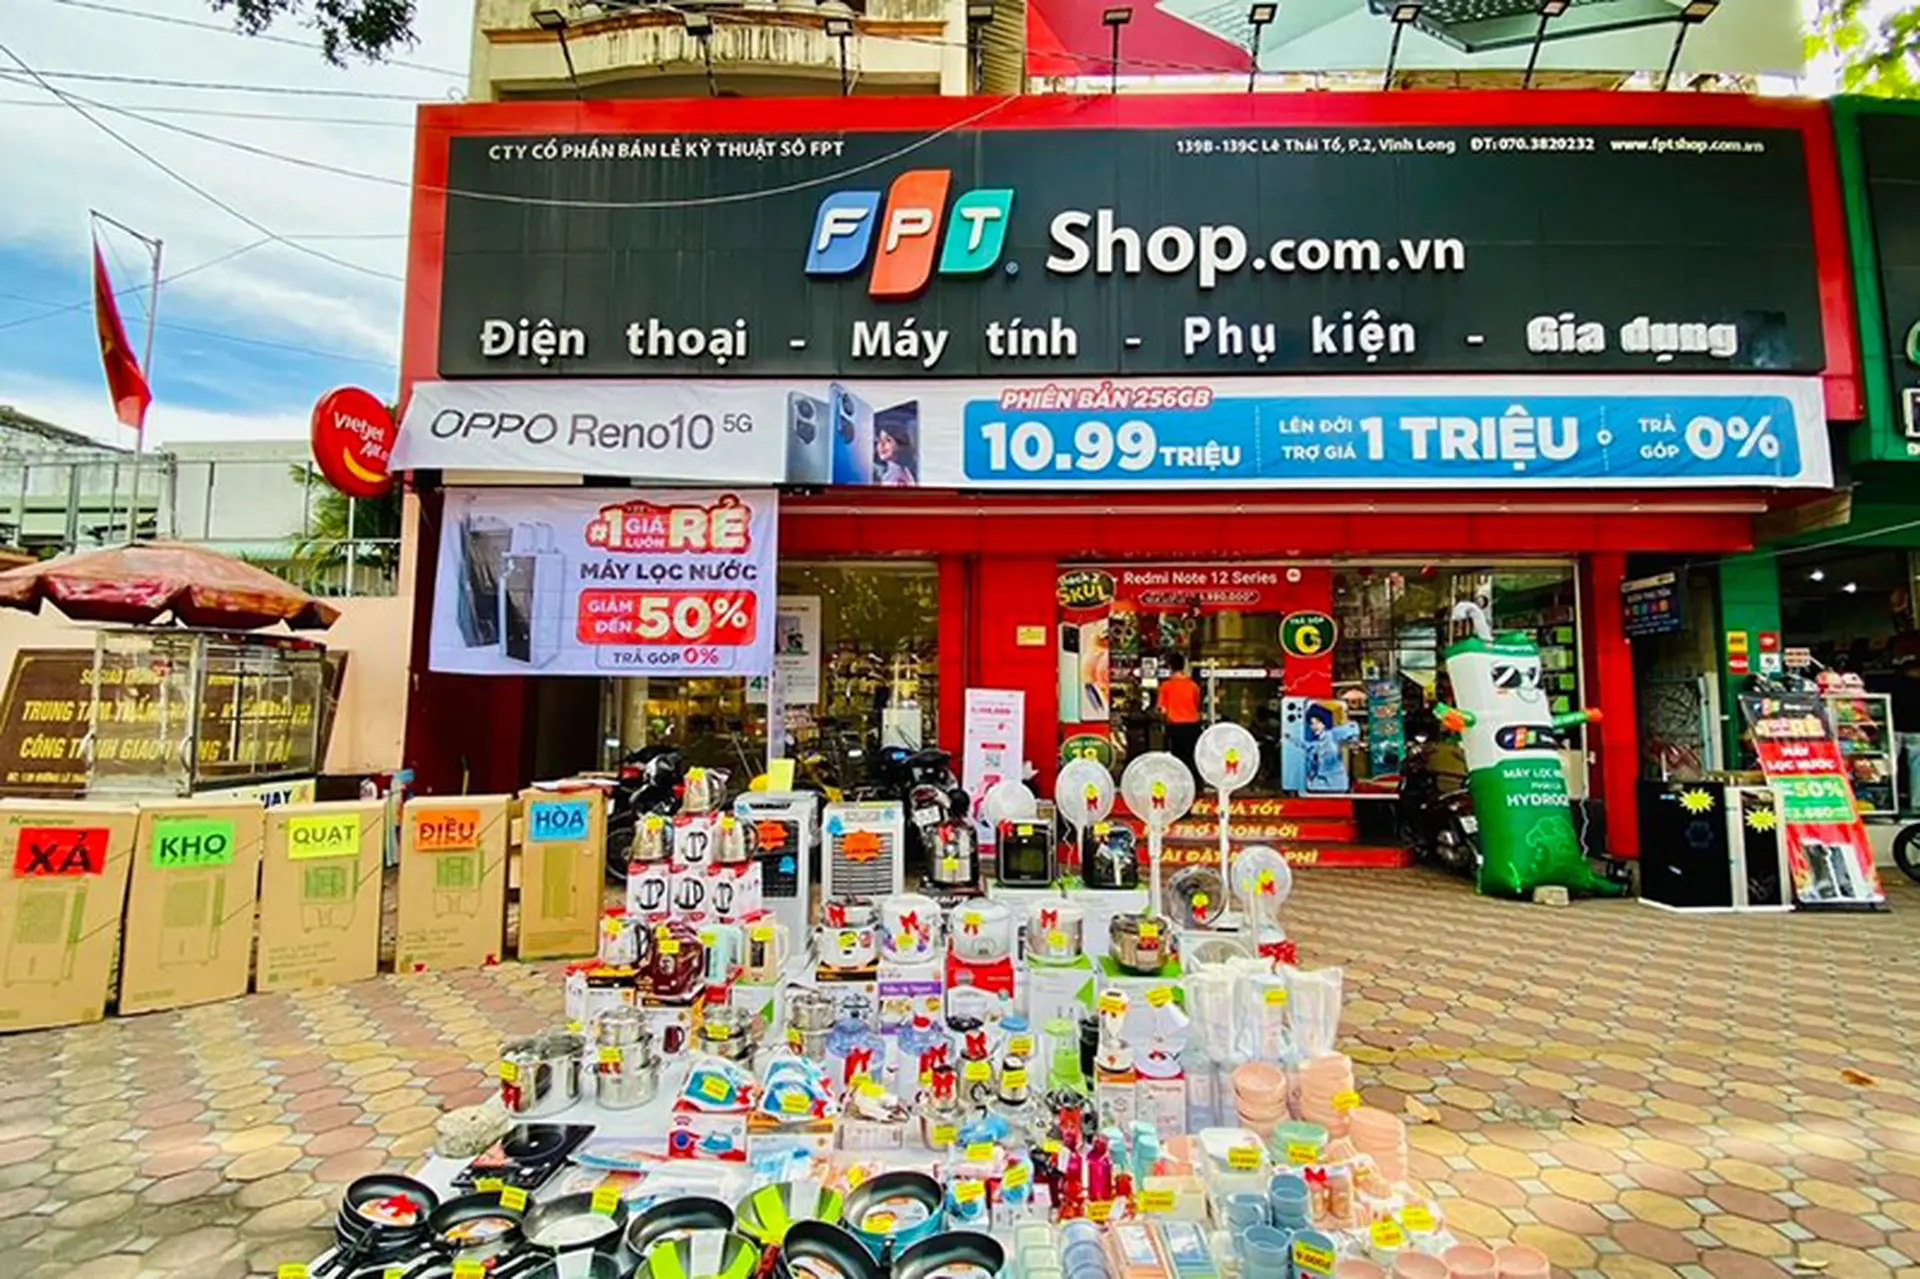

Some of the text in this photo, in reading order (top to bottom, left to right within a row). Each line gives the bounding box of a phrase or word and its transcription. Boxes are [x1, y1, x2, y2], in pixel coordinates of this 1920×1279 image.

[489, 145, 526, 160] CTY
[810, 140, 845, 156] FPT
[1284, 138, 1318, 151] Thái
[1417, 139, 1456, 154] Long
[815, 206, 1001, 253] FPT
[481, 319, 585, 365] Điện
[626, 318, 748, 365] thoại
[850, 319, 949, 368] Máy
[985, 318, 1078, 357] tính
[1183, 315, 1277, 364] Phụ
[1312, 310, 1417, 363] kiện
[1620, 316, 1738, 362] dụng
[1001, 381, 1212, 409] PHIÊN BẢN 256GB
[334, 411, 385, 441] Vietjet
[430, 409, 753, 450] OPPO Reno10 5G
[1279, 415, 1353, 434] LÊN ĐỜI
[1360, 403, 1580, 471] 1 TRIỆU
[1638, 413, 1780, 460] TRẢ 0%
[981, 419, 1242, 471] 10.99 TRIỆU
[1281, 440, 1357, 460] TRỢ GIÁ
[1639, 441, 1680, 460] GÓP
[587, 509, 623, 547] #1
[625, 515, 664, 534] GIÁ
[669, 493, 749, 548] RẺ
[580, 558, 757, 585] MÁY LỌC NƯỚC
[1123, 570, 1277, 585] Redmi Note 12 Series
[588, 594, 749, 639] GIẢM 50%
[595, 613, 632, 633] ĐẾN
[613, 647, 721, 664] TRẢ GÓP 0%
[22, 700, 73, 722] TRUNG
[20, 734, 64, 760] CÔNG
[419, 815, 475, 842] ĐIỀU
[535, 804, 585, 830] HÒA
[25, 831, 93, 874] XẢ
[159, 833, 227, 859] KHO
